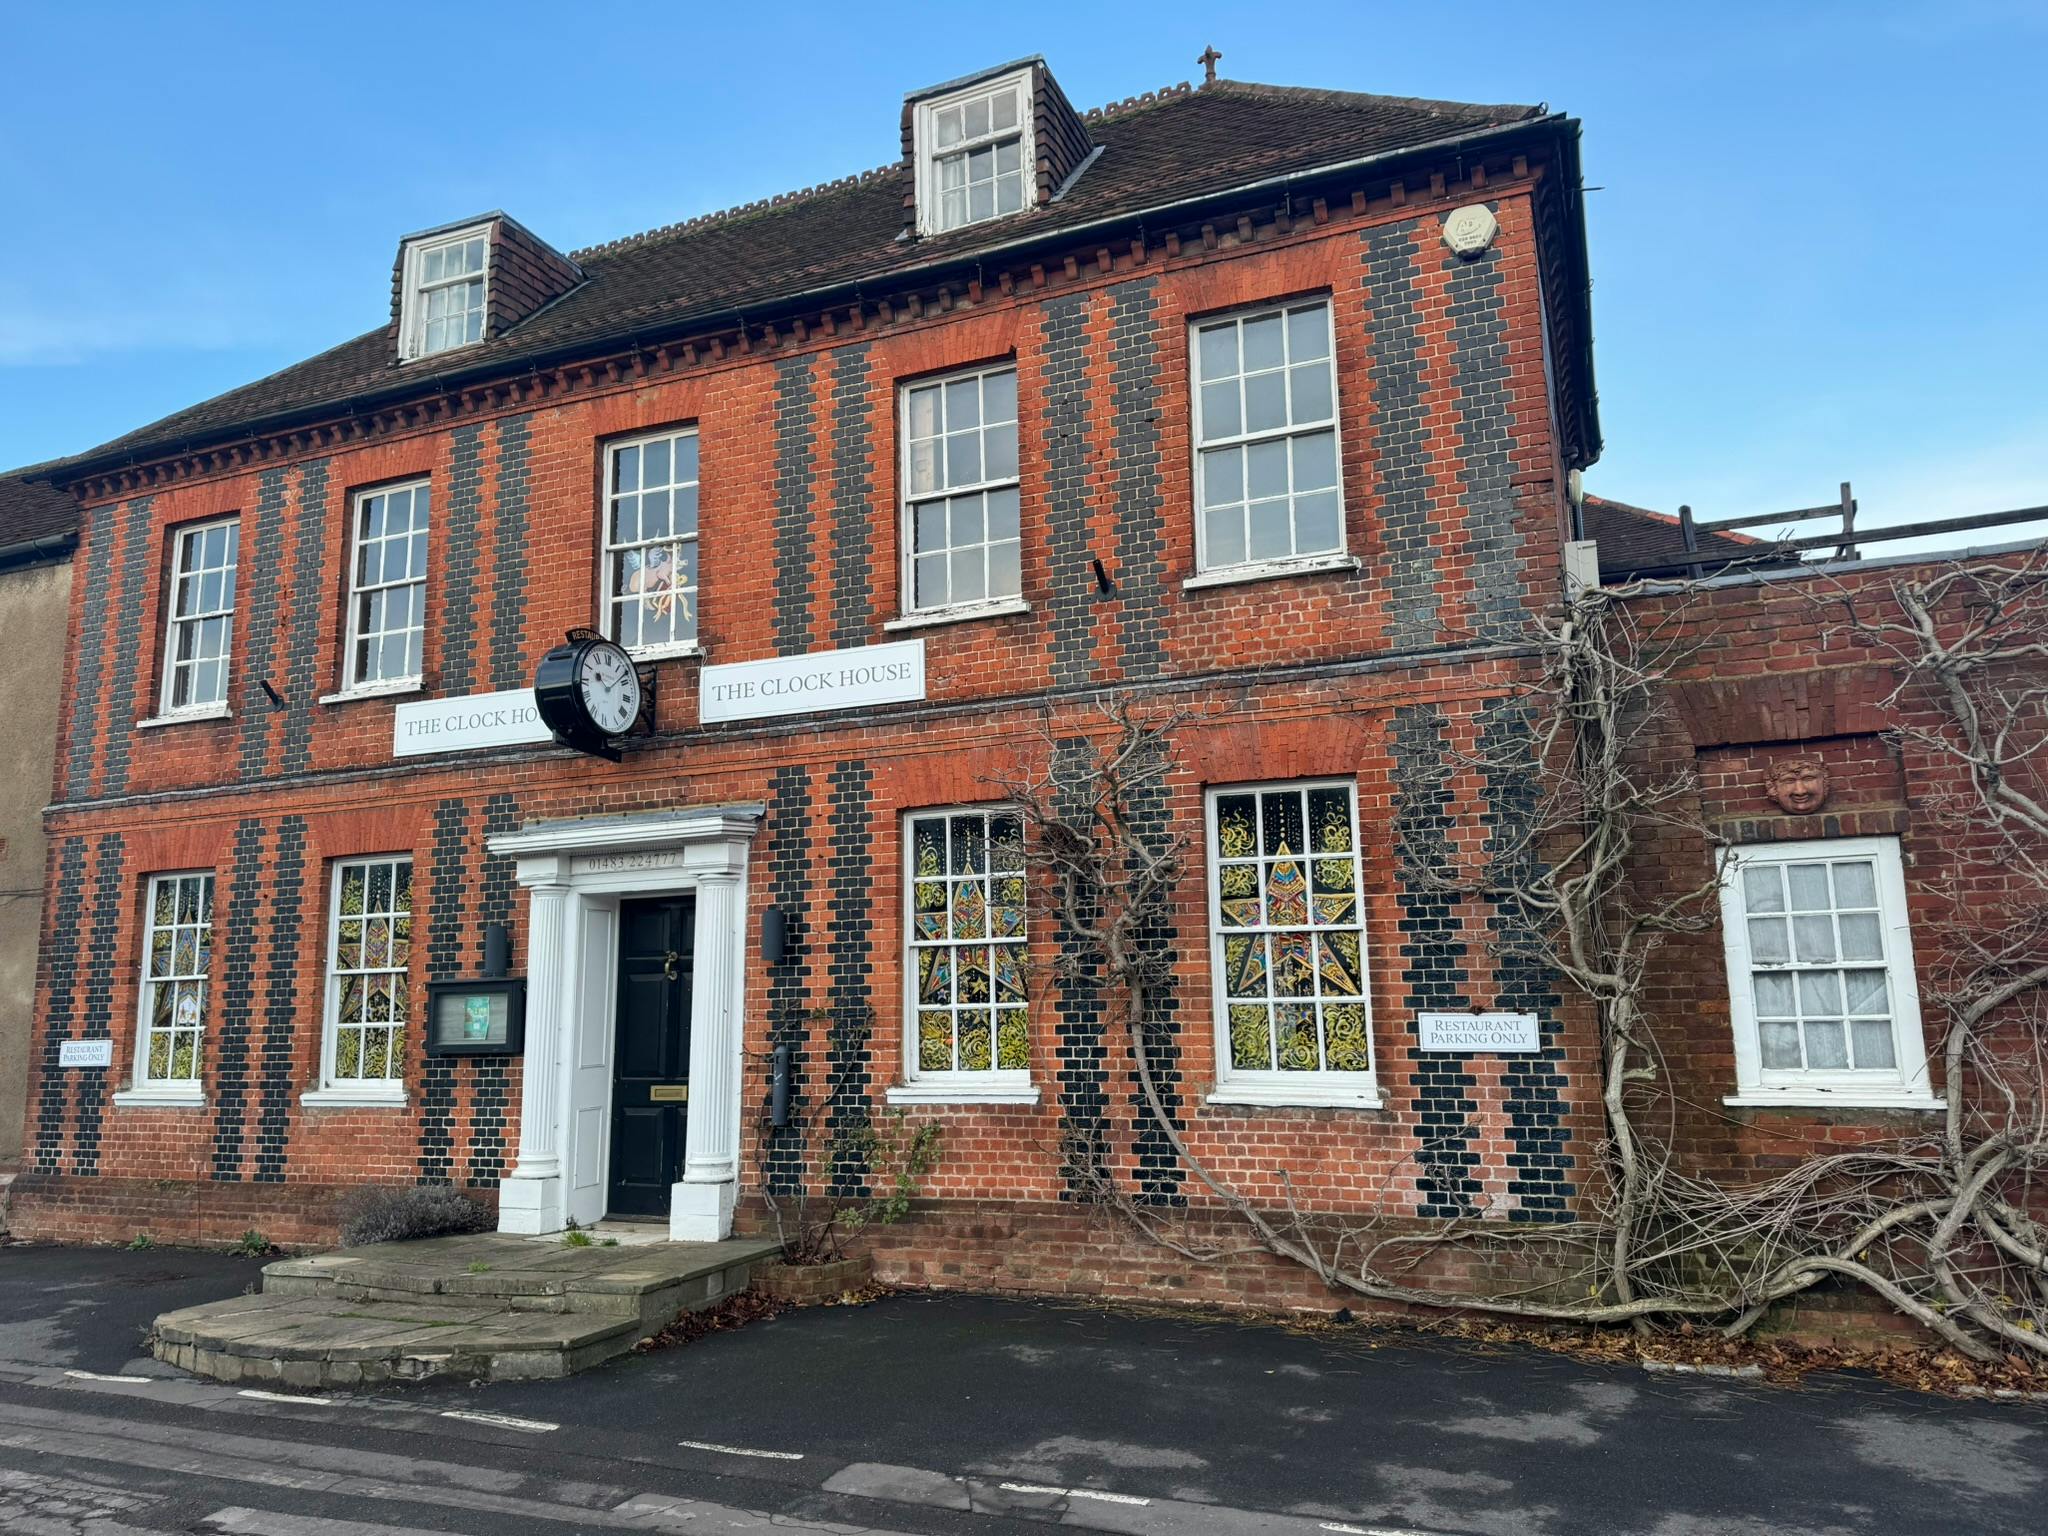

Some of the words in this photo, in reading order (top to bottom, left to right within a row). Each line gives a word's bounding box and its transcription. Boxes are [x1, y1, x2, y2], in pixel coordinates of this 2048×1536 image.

[712, 681, 755, 701] THE
[761, 672, 834, 696] CLOCK
[839, 662, 911, 687] HOUSE
[405, 718, 441, 736] THE
[445, 710, 507, 732] CLOCK
[589, 856, 624, 870] 01483
[629, 852, 676, 867] 224777
[1435, 1019, 1522, 1031] RESTAURANT
[1431, 1032, 1488, 1044] PARKING
[1491, 1032, 1528, 1044] ONLY
[66, 1045, 103, 1054] RESTAURANT
[63, 1053, 88, 1062] PARKING
[88, 1053, 105, 1061] ONLY
